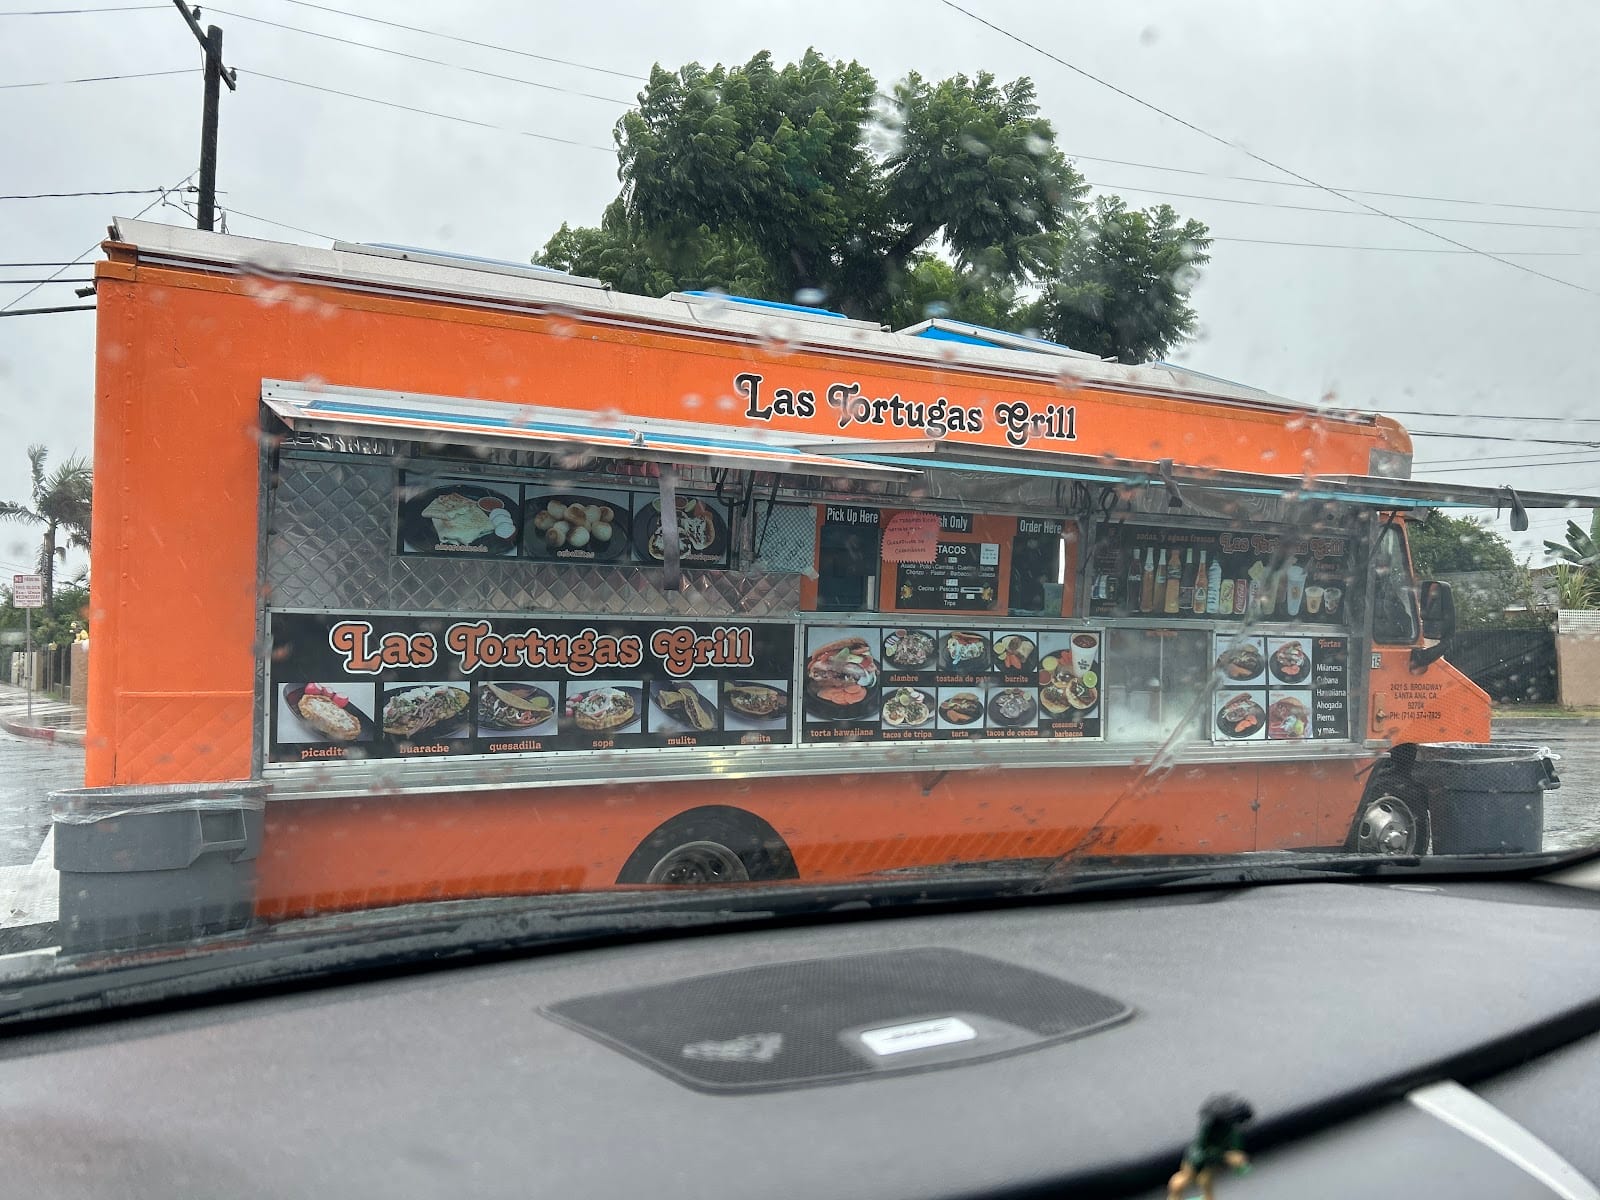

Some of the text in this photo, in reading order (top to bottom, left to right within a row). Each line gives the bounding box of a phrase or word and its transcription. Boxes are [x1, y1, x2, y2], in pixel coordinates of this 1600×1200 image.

[733, 373, 1077, 446] Las Tortugas Grill
[826, 507, 844, 522] Pick
[847, 509, 858, 525] Up
[860, 510, 879, 524] Here
[950, 515, 968, 532] Only
[1020, 519, 1062, 535] Order Here
[1220, 533, 1249, 554] Las
[937, 544, 966, 555] TACOS
[330, 620, 755, 678] Las Tortugas Grill
[1318, 639, 1341, 649] Tortas
[1317, 664, 1342, 672] Milanesa
[890, 674, 919, 683] alambre
[936, 674, 962, 683] tostada
[963, 674, 973, 683] de
[1005, 675, 1028, 684] burrito
[1317, 676, 1339, 685] Cubana
[1317, 701, 1343, 711] Ahogada
[1317, 713, 1335, 722] Pierna
[811, 727, 875, 738] torta hawaiiana
[883, 730, 932, 740] tacos de tripa
[951, 730, 969, 738] torta
[986, 728, 1039, 737] tacos de cecina
[592, 739, 614, 750] sope
[667, 734, 697, 745] mulita
[399, 743, 450, 754] huarache
[490, 742, 541, 755] quesadilla
